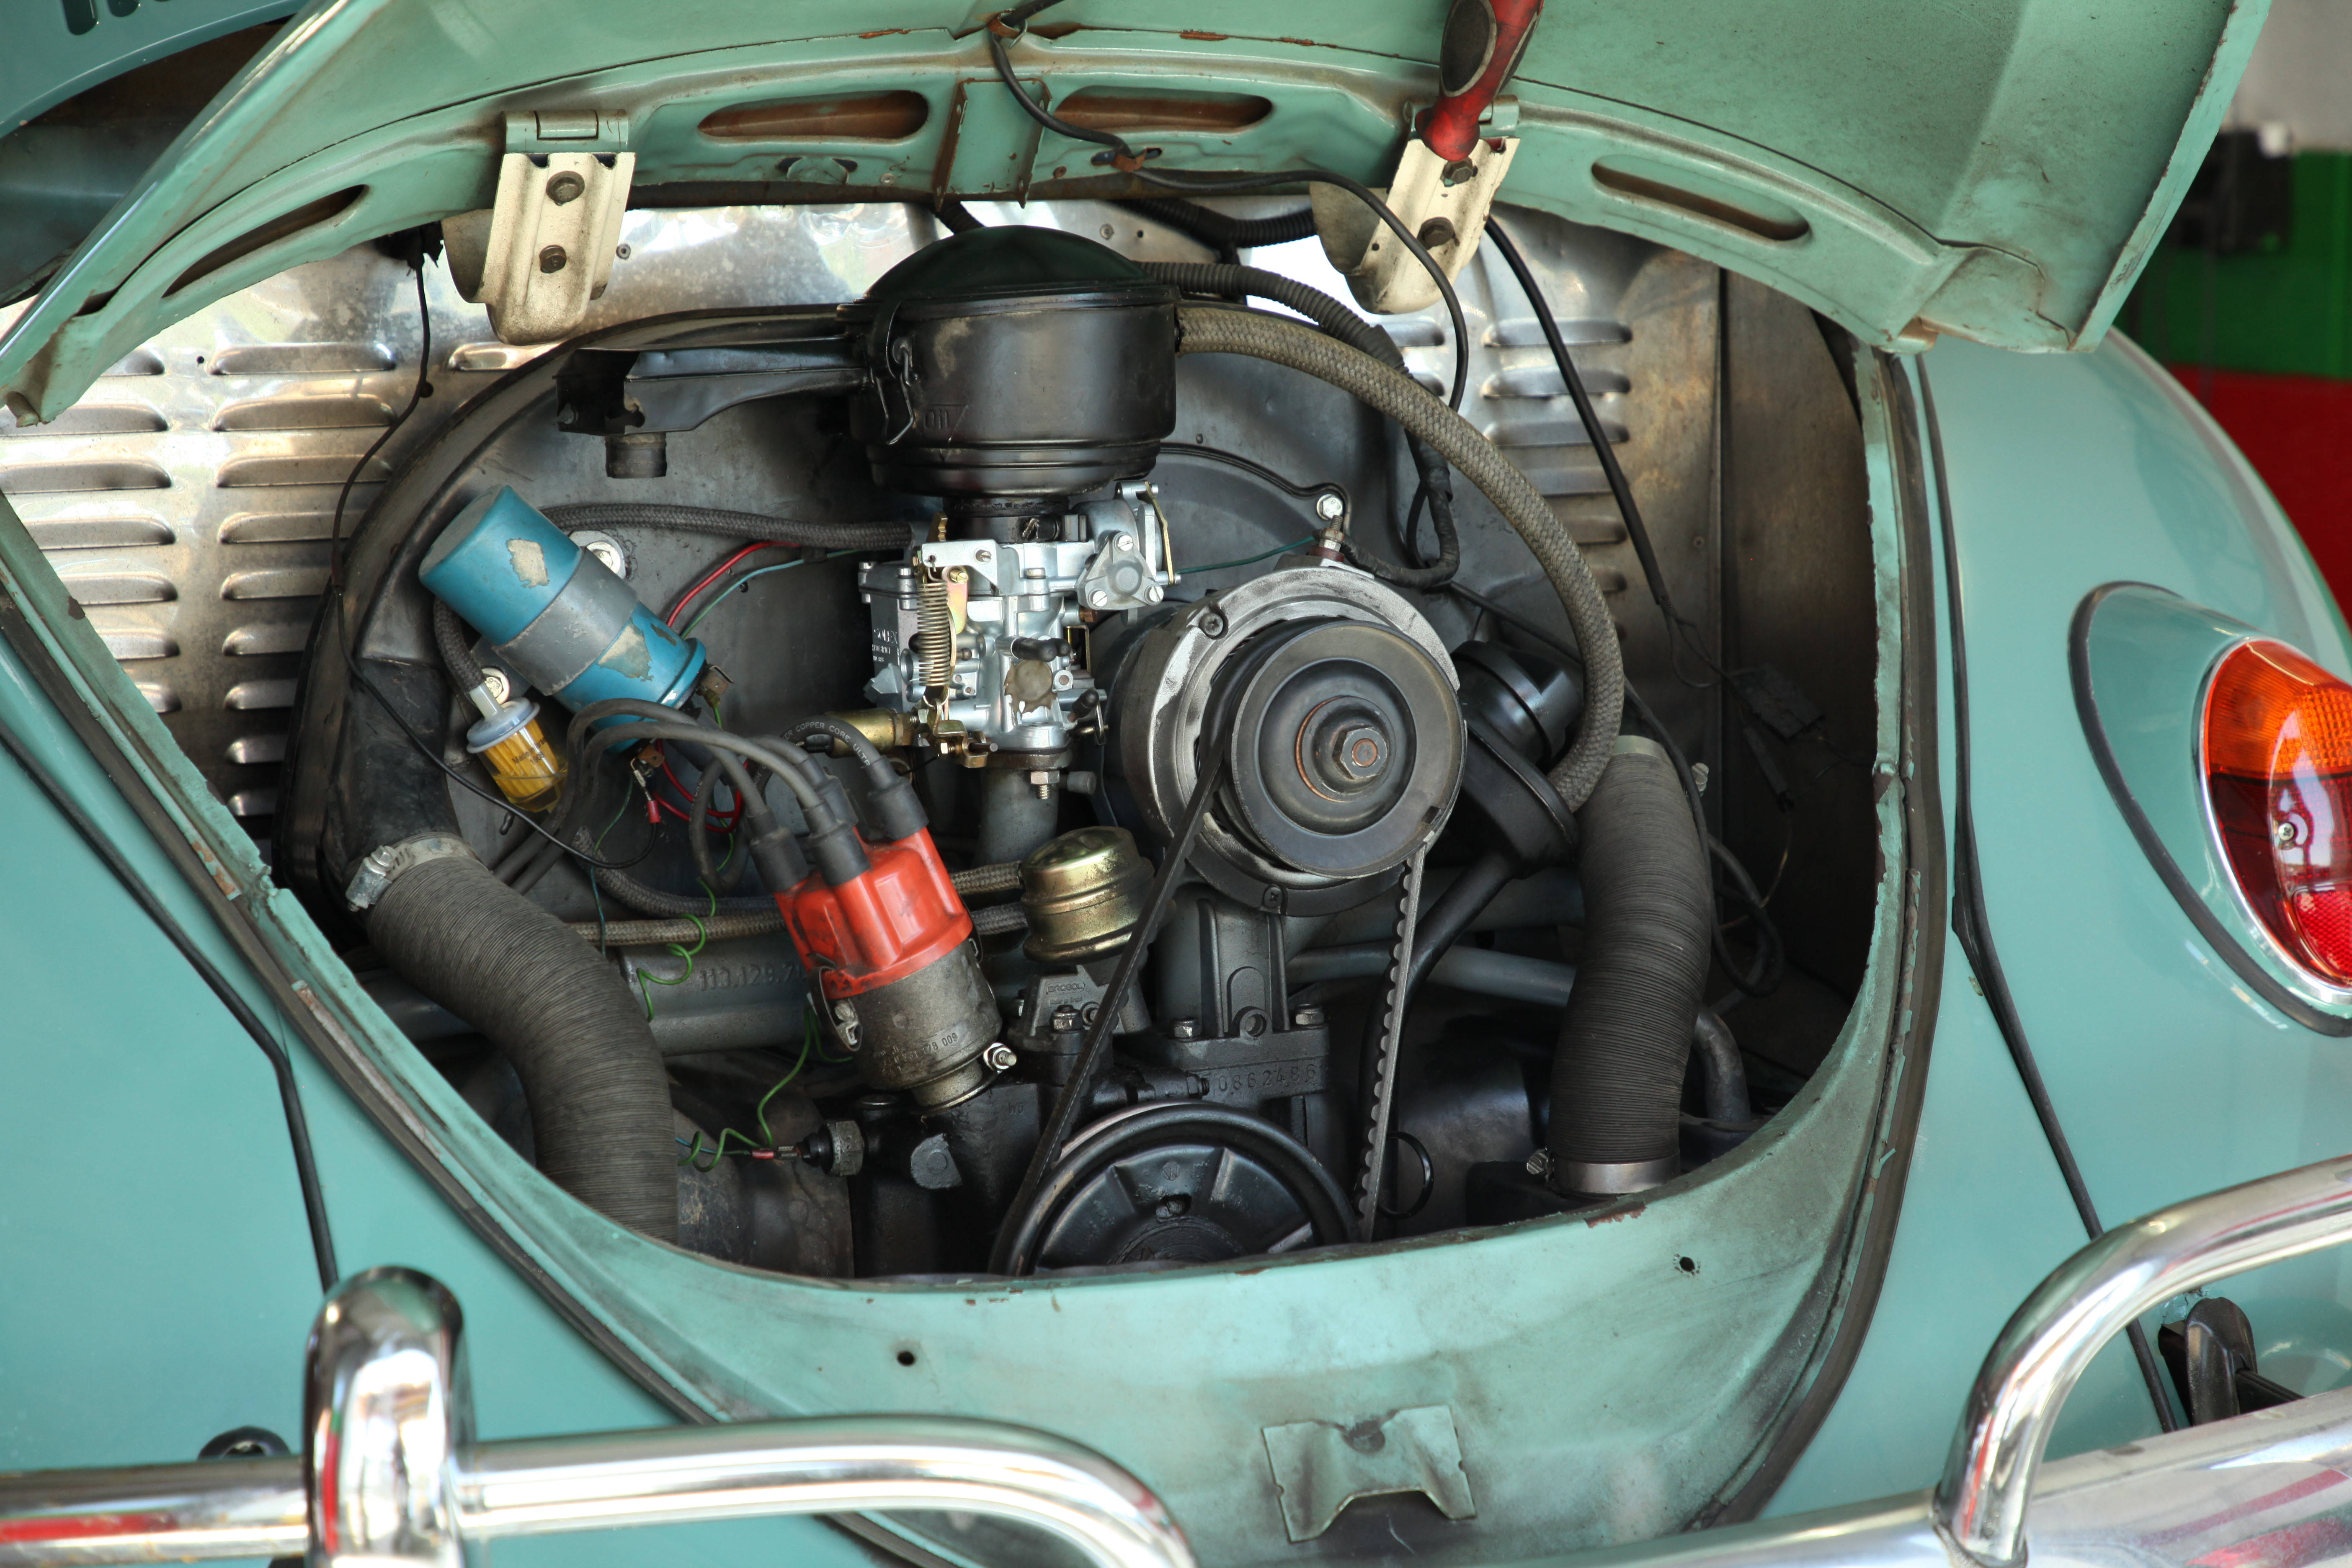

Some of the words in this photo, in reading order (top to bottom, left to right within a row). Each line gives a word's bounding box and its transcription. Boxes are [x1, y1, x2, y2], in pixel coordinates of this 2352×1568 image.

[796, 722, 825, 732] COPPER
[829, 725, 851, 743] CORE
[853, 743, 870, 766] ULTR
[941, 1032, 958, 1047] 009
[1219, 1063, 1316, 1092] 0862486
